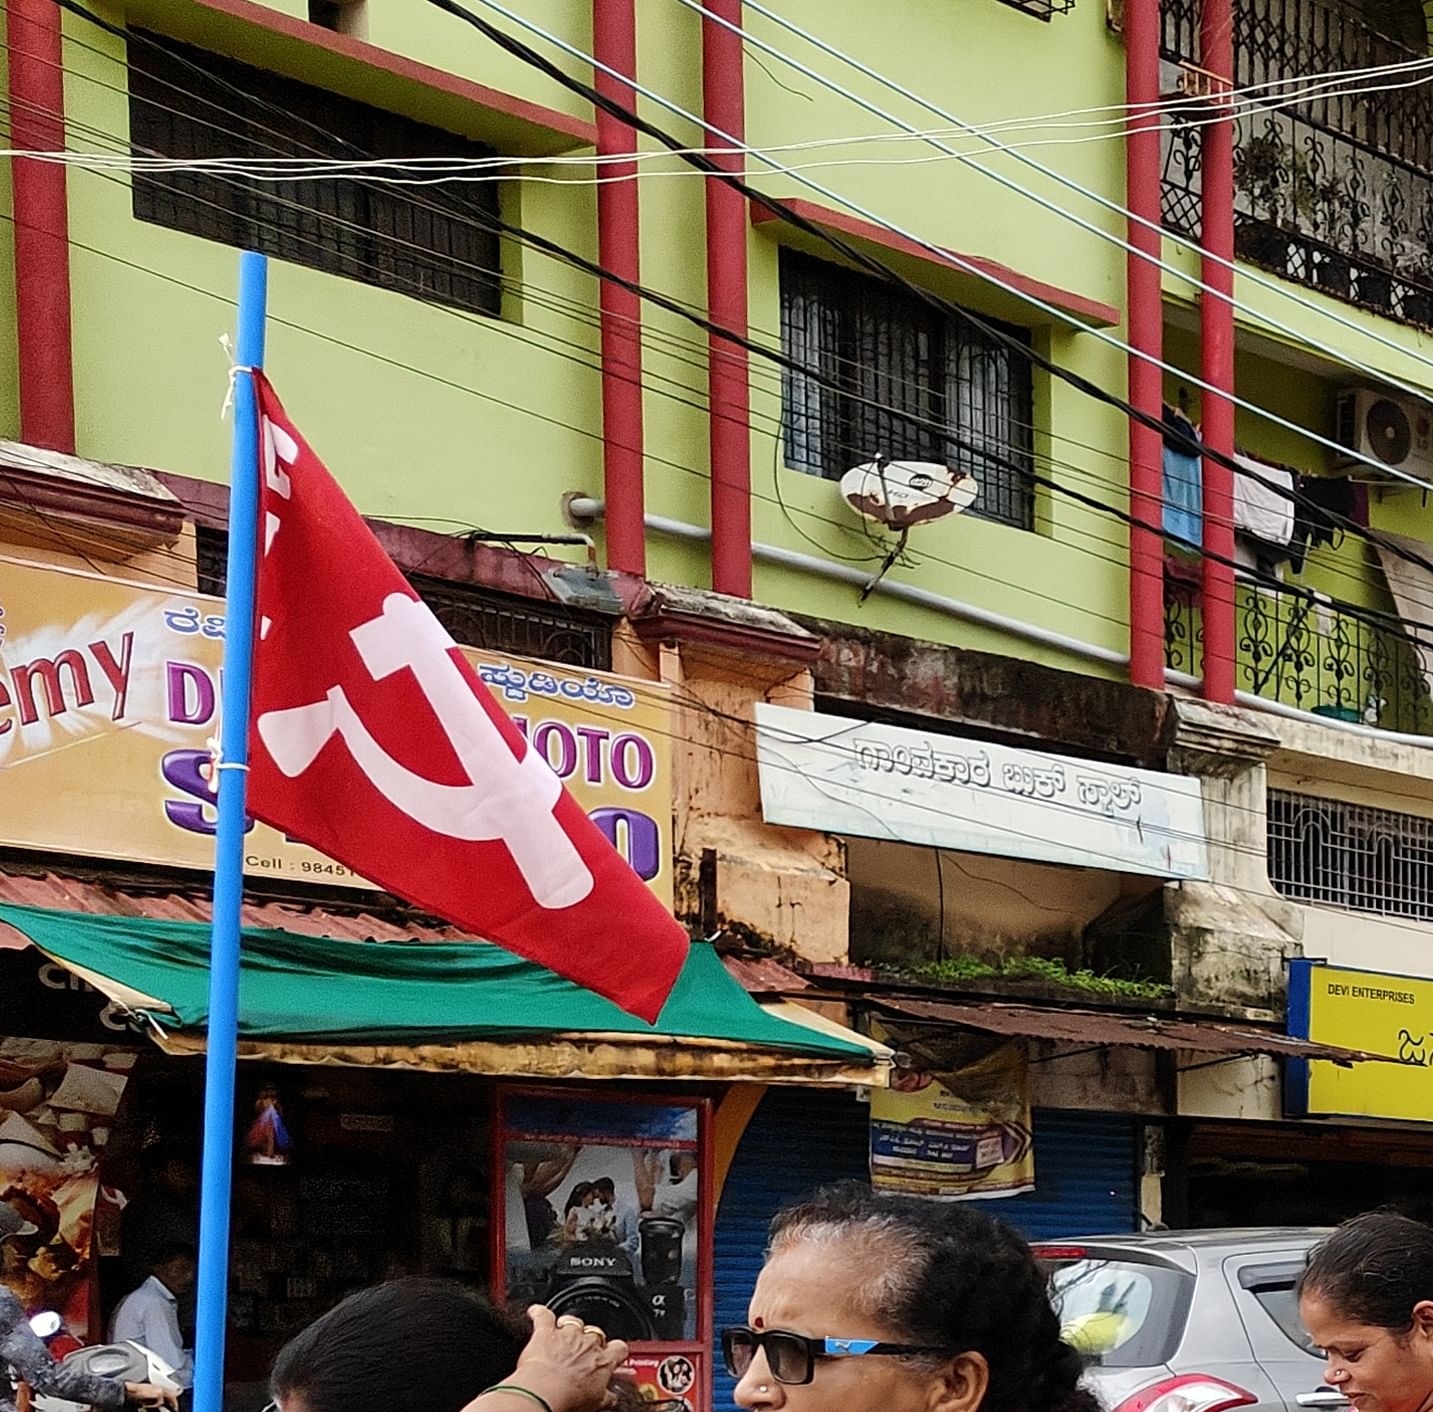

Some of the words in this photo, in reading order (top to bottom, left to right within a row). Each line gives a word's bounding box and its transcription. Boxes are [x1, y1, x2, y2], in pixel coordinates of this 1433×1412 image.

[245, 855, 282, 870] Cell
[1327, 983, 1350, 997] DEVI
[1351, 986, 1416, 1005] ENTERPRISES
[569, 1256, 617, 1268] SONY
